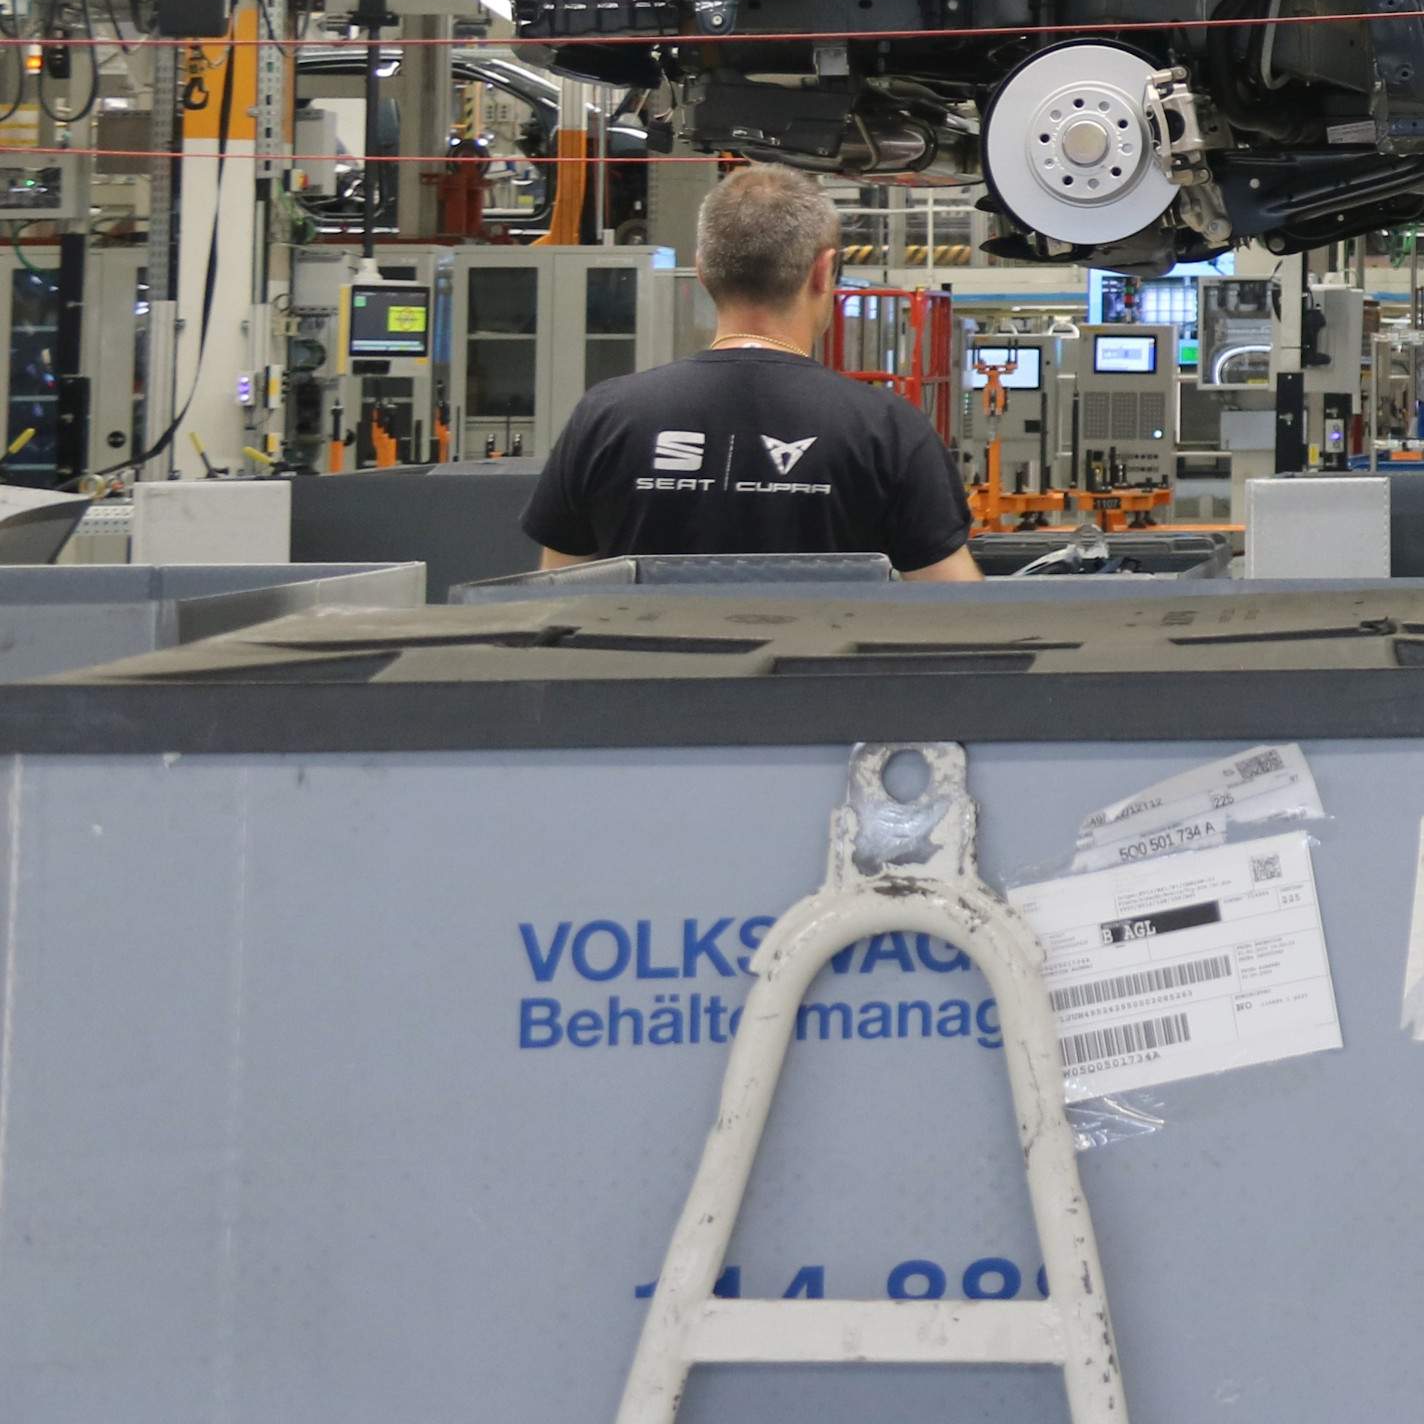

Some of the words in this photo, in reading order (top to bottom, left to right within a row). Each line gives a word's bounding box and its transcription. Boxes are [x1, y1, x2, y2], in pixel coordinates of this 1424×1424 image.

[636, 477, 715, 492] SEAT
[735, 481, 832, 495] CUPRA
[1150, 834, 1173, 852] 501
[1177, 826, 1201, 844] 734
[1205, 821, 1216, 835] A
[1102, 928, 1113, 944] B
[1124, 920, 1157, 940] AGL
[519, 993, 1004, 1049] Behältmanag
